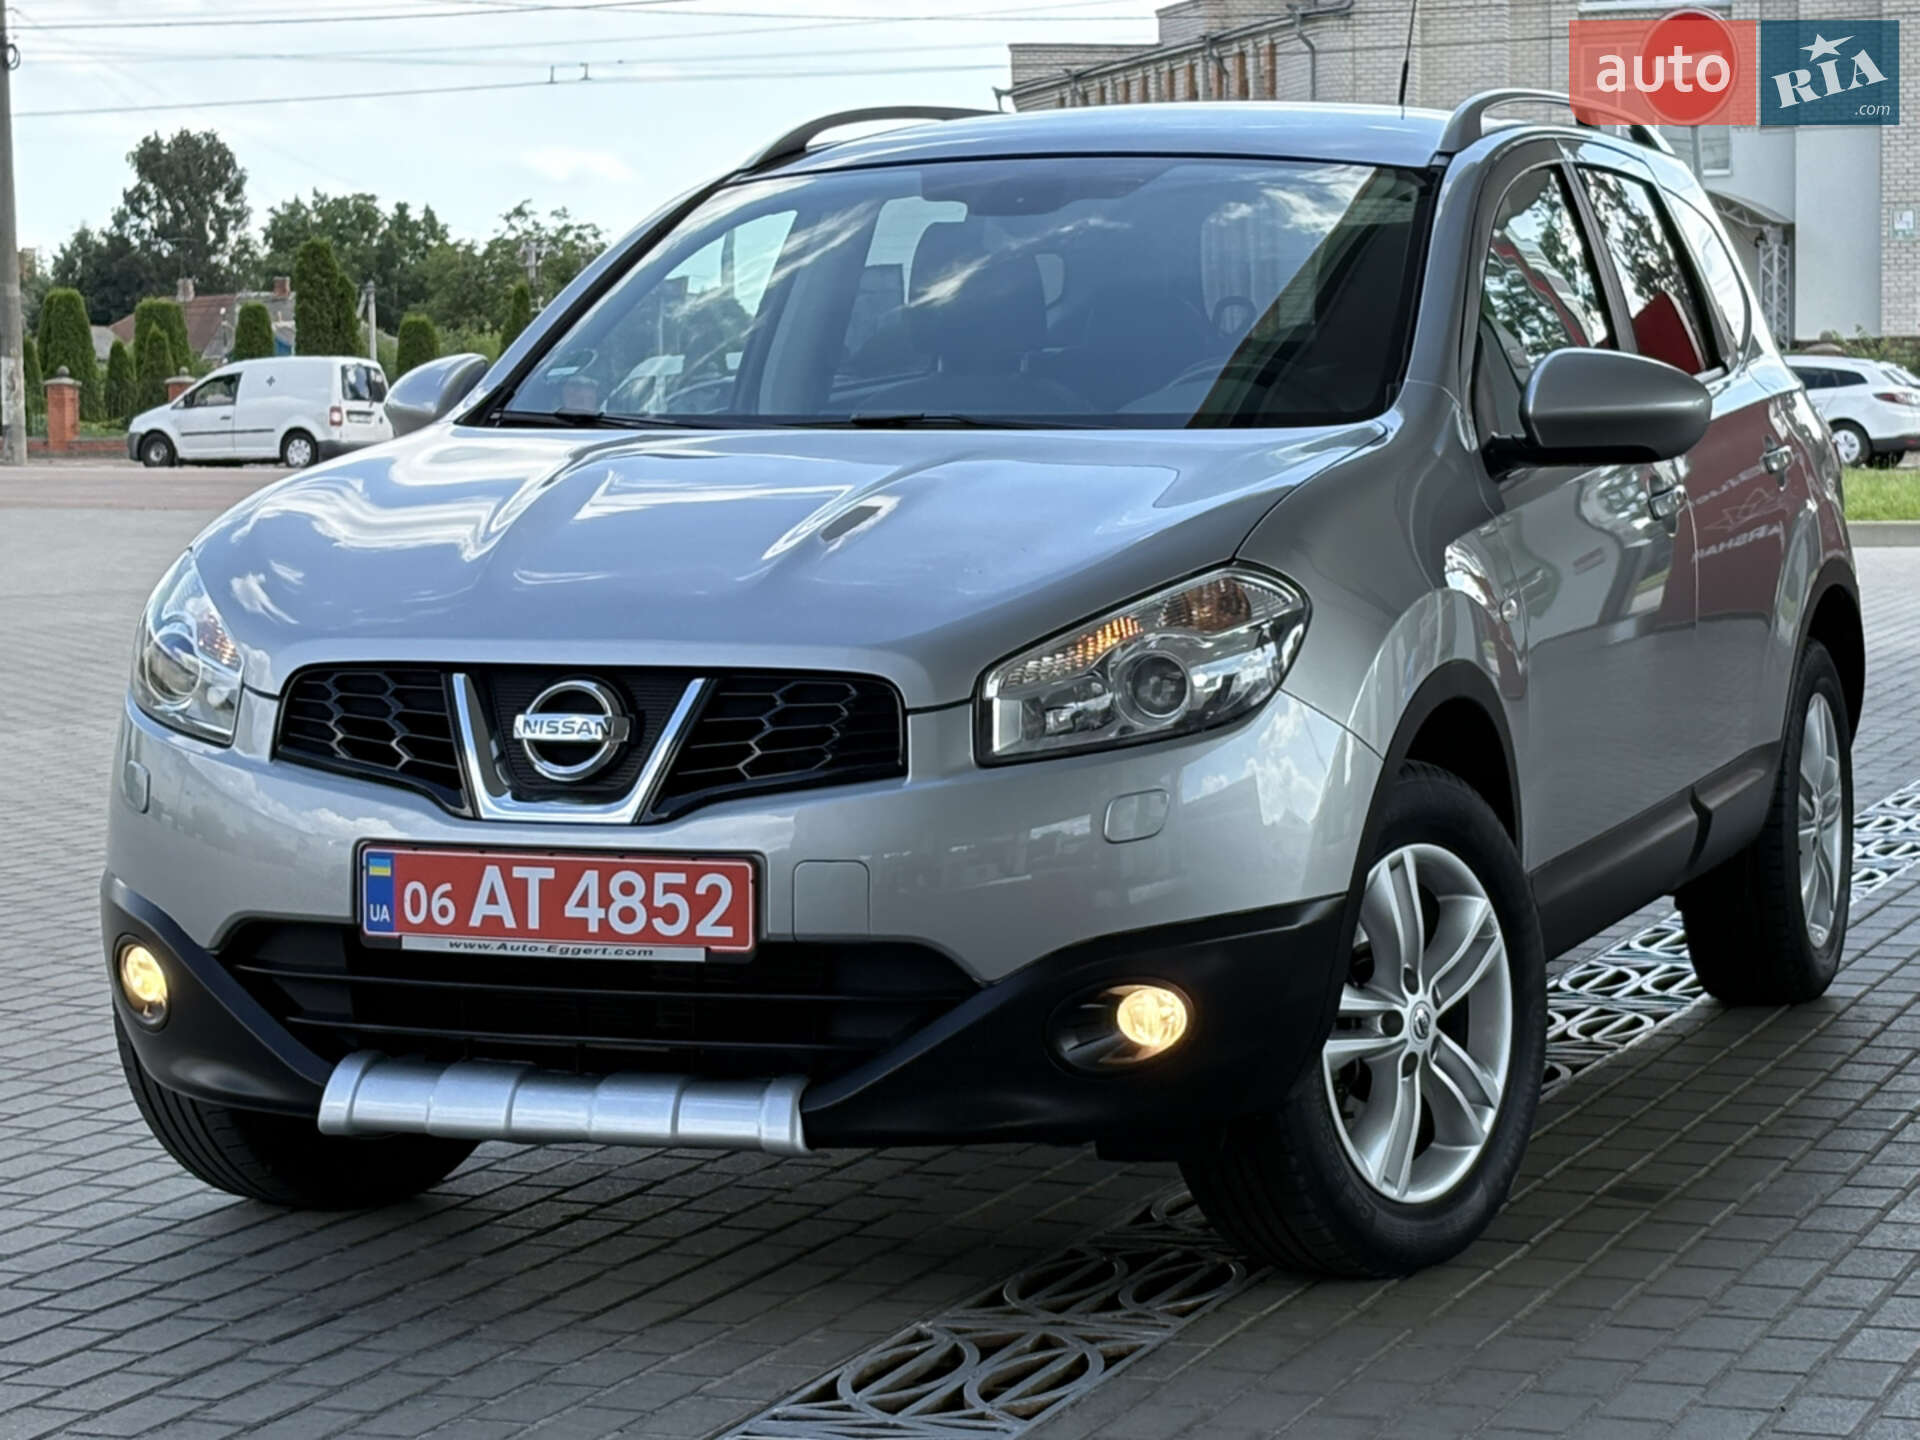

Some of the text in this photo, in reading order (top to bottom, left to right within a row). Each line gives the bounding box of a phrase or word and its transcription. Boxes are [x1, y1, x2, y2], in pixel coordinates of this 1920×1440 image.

[522, 718, 612, 736] NISSAN
[403, 865, 734, 938] 06 AT 4852
[370, 904, 391, 923] UA
[449, 940, 654, 957] www.Auto-Eggert.com
